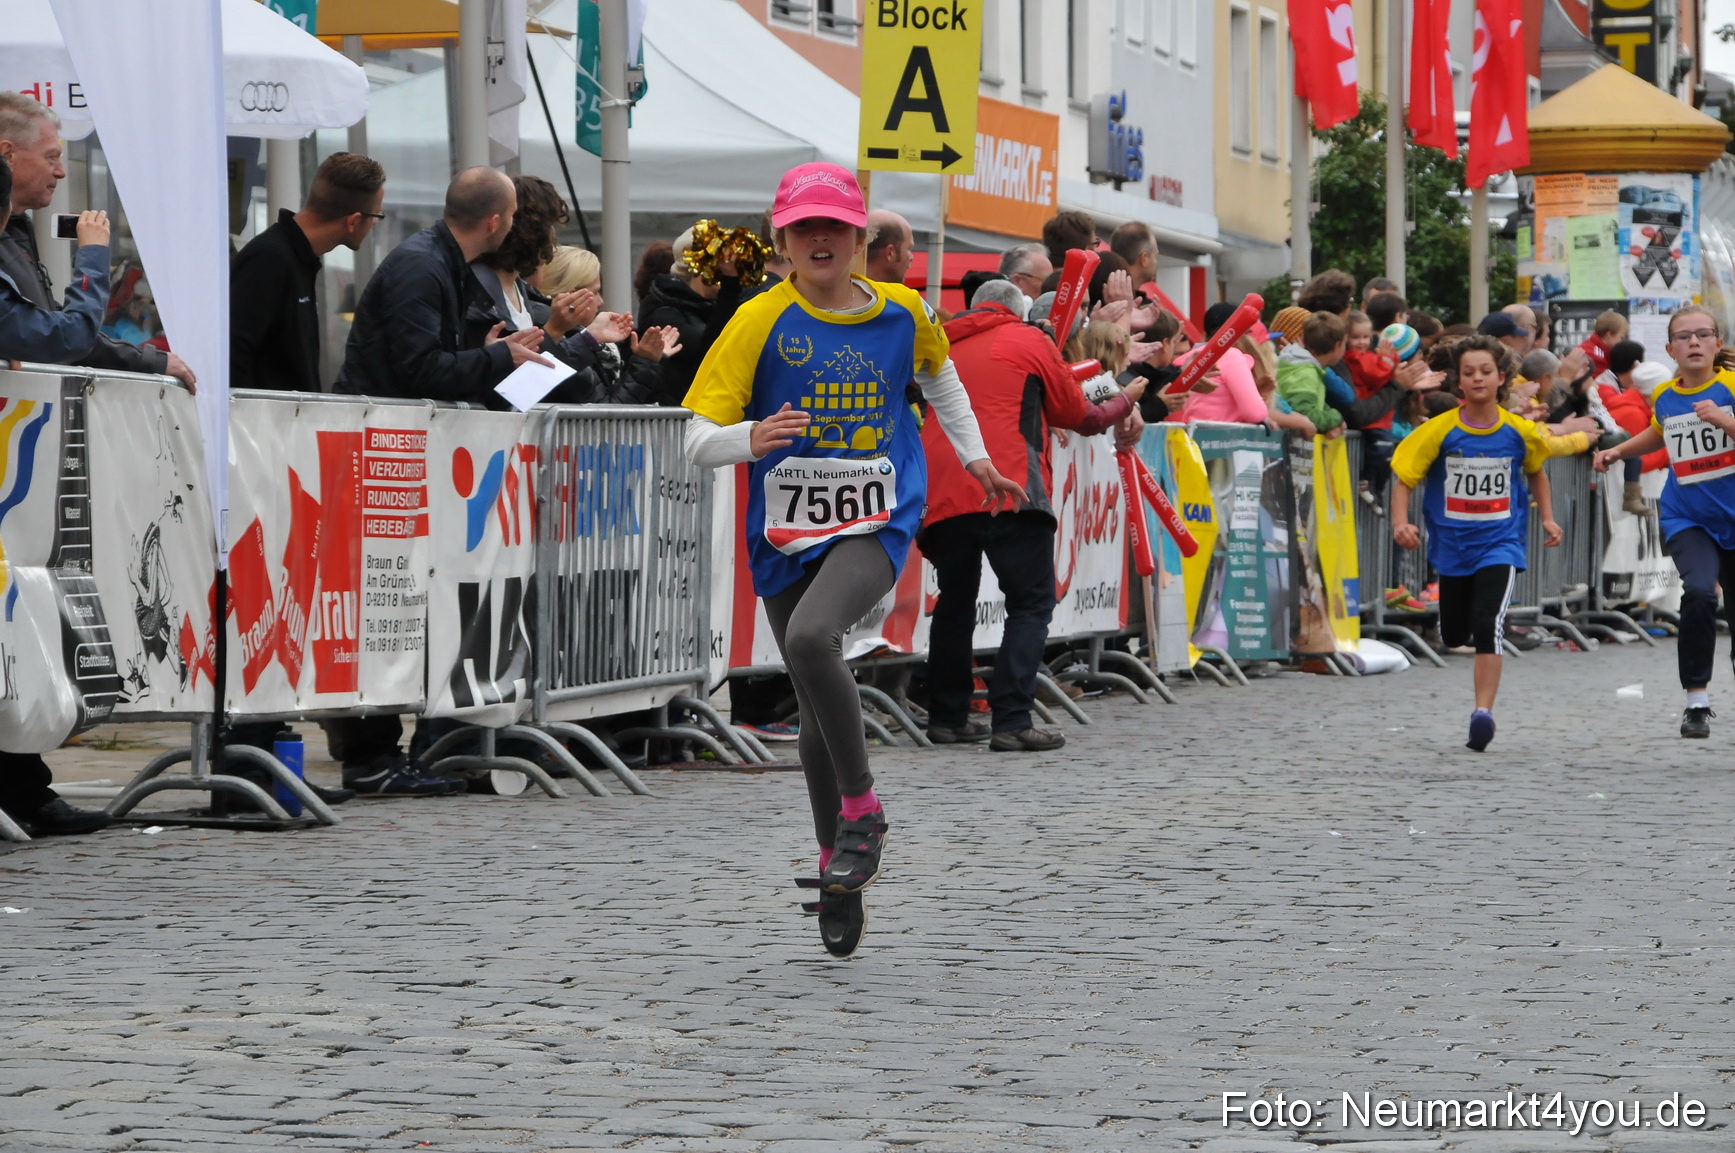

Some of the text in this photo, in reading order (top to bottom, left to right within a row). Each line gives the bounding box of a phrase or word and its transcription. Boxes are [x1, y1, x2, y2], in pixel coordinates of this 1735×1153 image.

[878, 0, 968, 31] Block
[882, 45, 951, 133] A
[785, 346, 806, 354] Jahre
[1181, 350, 1215, 385] Audi BKK
[1671, 427, 1728, 458] 7167
[768, 465, 874, 480] PARTL Neumarkt
[1690, 459, 1720, 473] Meike
[1141, 473, 1170, 511] Audi BKK
[1453, 472, 1505, 496] 7049
[778, 480, 887, 525] 7560
[366, 554, 392, 570] Braun
[365, 573, 377, 588] Am
[366, 592, 398, 607] D-92318
[365, 638, 376, 652] Fax
